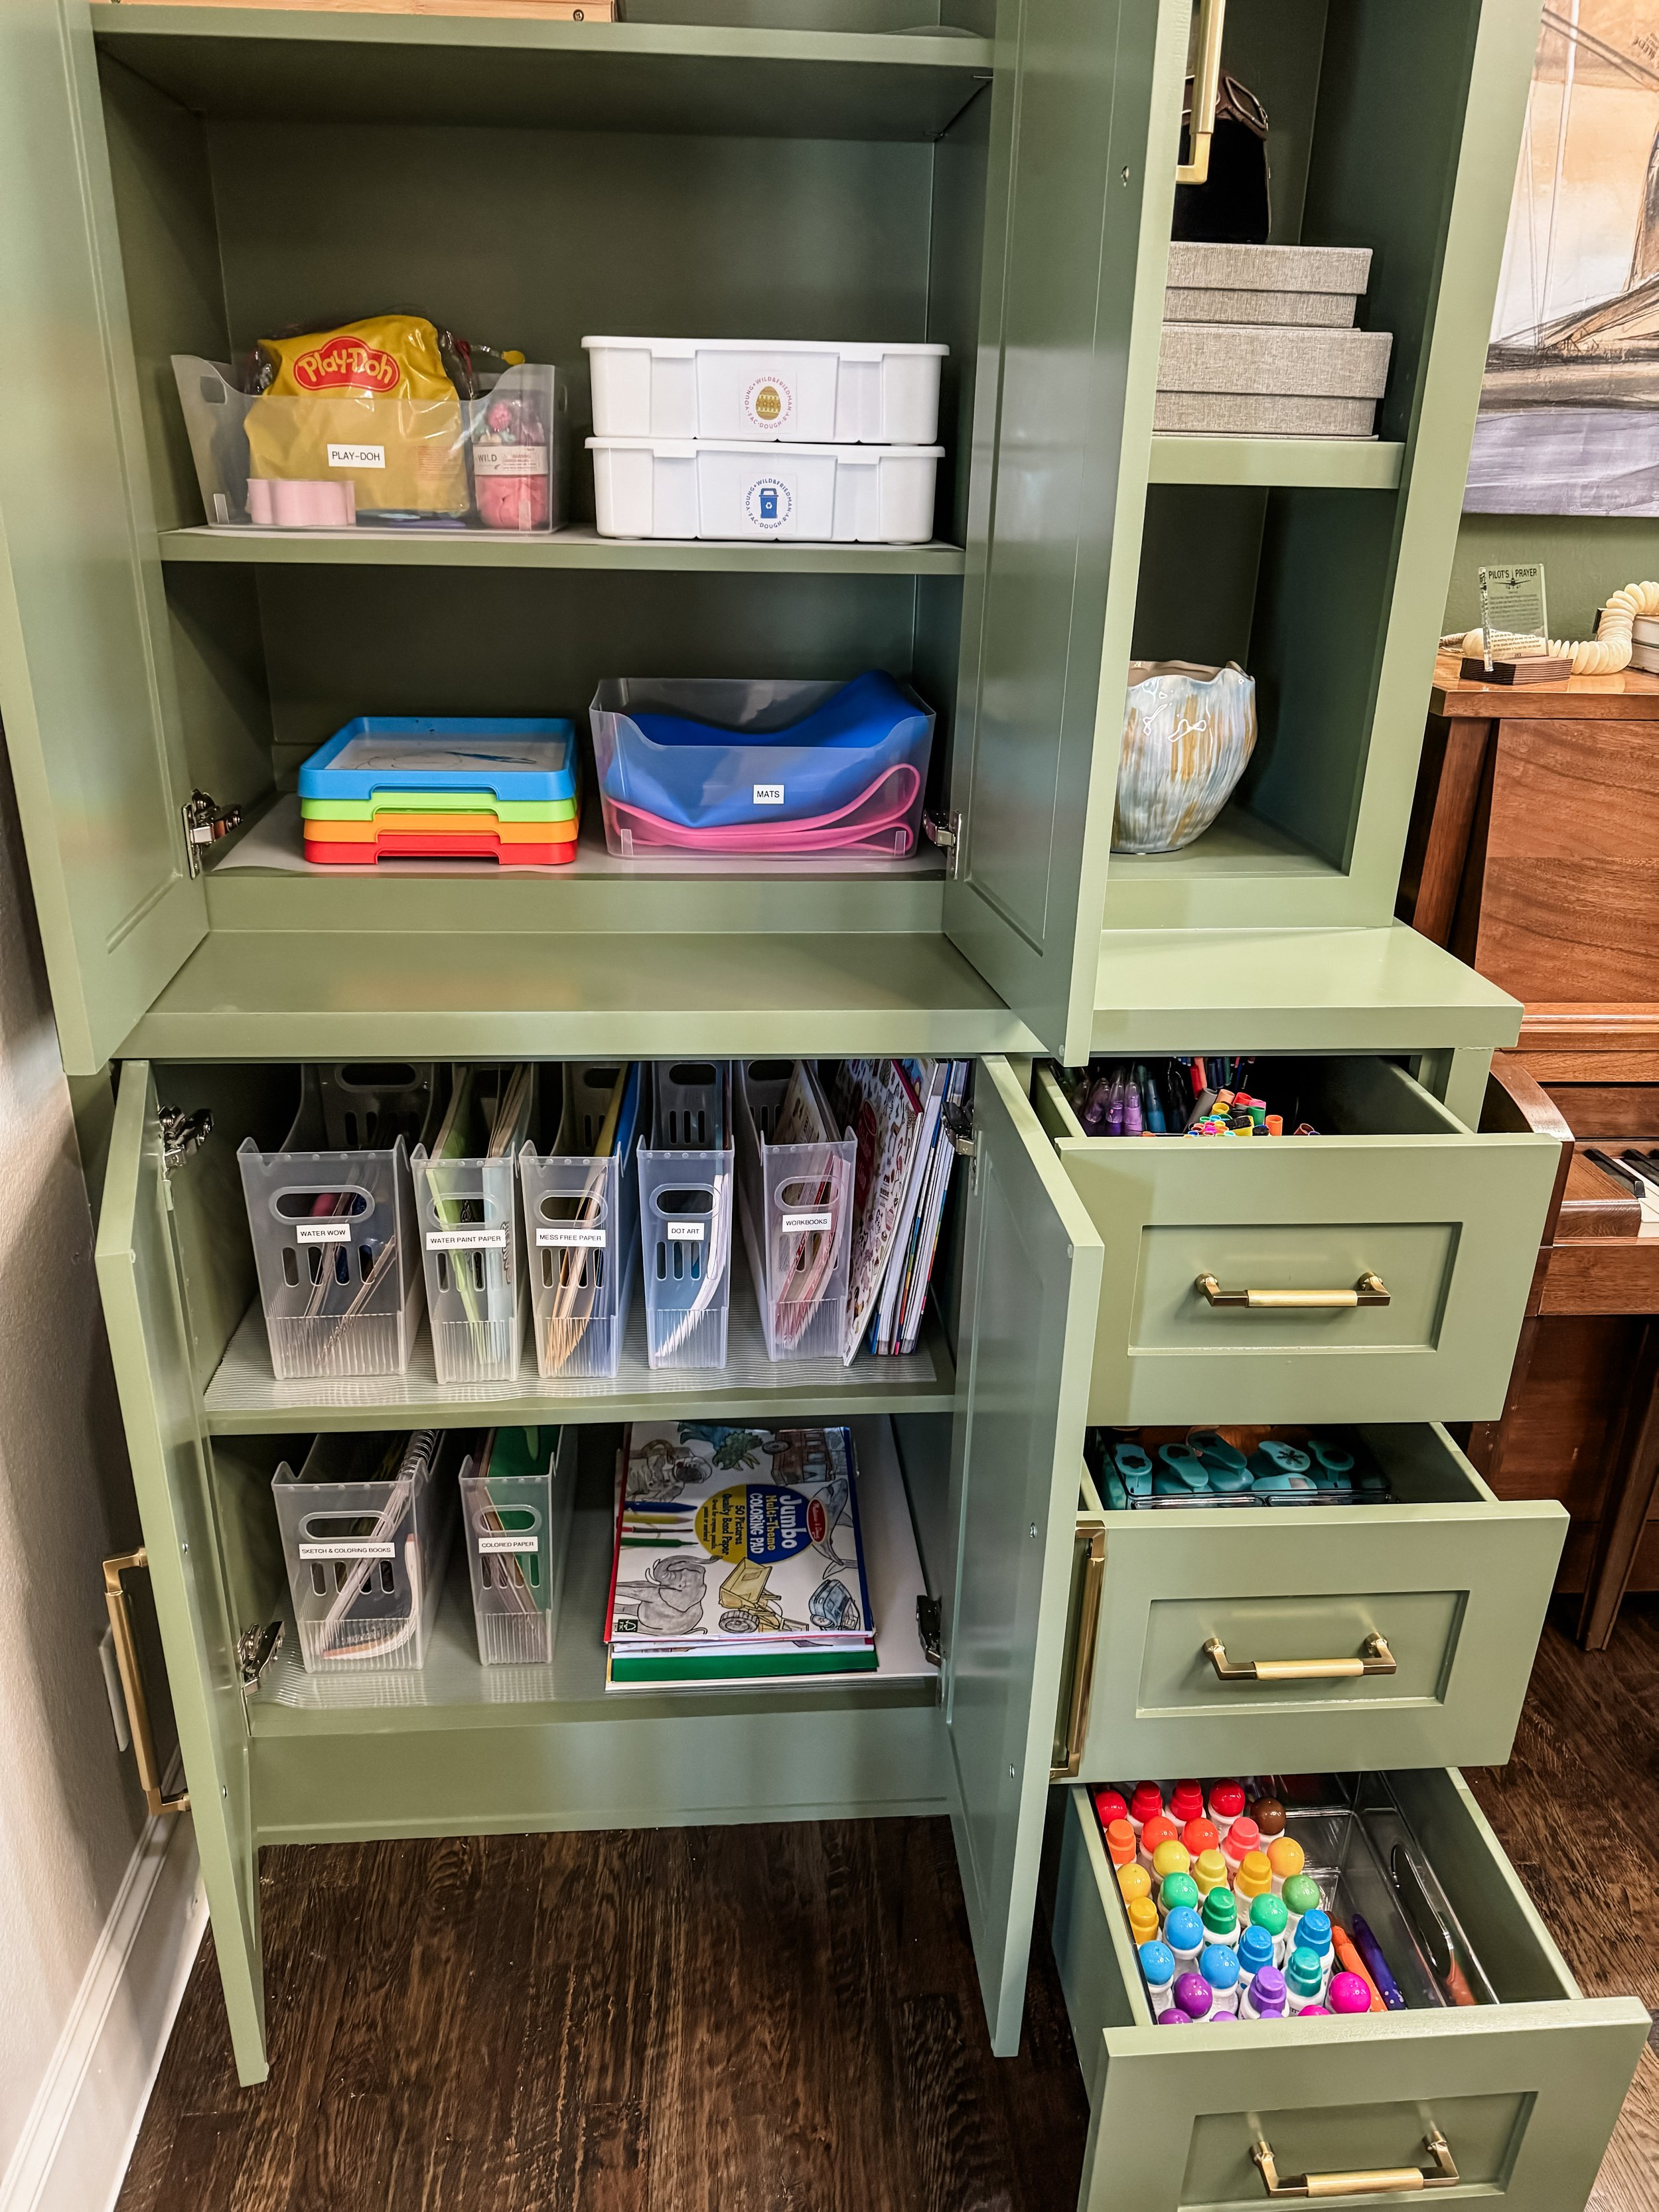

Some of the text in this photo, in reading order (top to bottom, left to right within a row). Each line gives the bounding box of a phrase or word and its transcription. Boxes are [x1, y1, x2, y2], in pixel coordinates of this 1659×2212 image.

[299, 347, 393, 384] Play-Doh
[745, 385, 754, 411] YOUNG
[331, 451, 381, 461] PLAY-DOH
[477, 454, 498, 463] WILD
[745, 486, 755, 511] YOUNG
[1488, 568, 1538, 579] PILOT'S PRAYER
[719, 1493, 734, 1516] Quality
[735, 1505, 745, 1545] 50 Pictures
[764, 1495, 780, 1551] Multi-Theme
[779, 1495, 808, 1550] Jumbo
[719, 1536, 733, 1556] Paper
[749, 1537, 764, 1554] PAD
